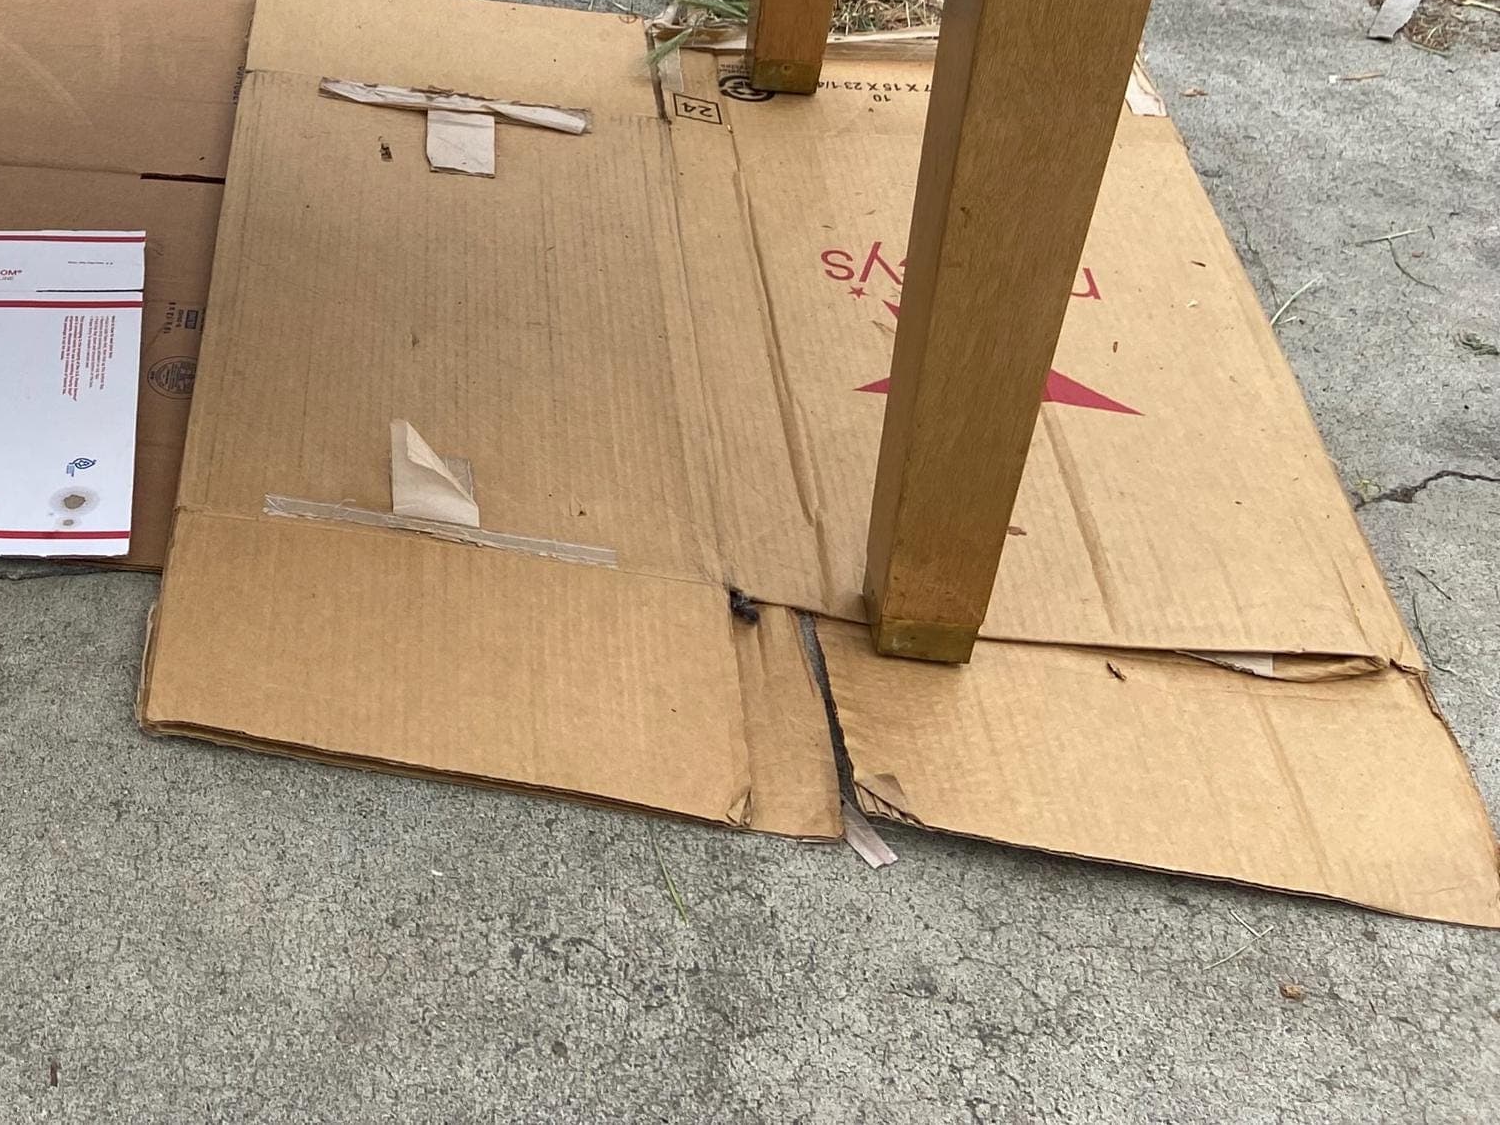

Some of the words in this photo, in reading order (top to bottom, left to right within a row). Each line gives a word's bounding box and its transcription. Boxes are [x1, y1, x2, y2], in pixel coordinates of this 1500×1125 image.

[866, 82, 879, 91] X
[883, 82, 900, 92] 15
[905, 83, 918, 92] X
[873, 94, 891, 102] 10
[683, 102, 713, 118] 24
